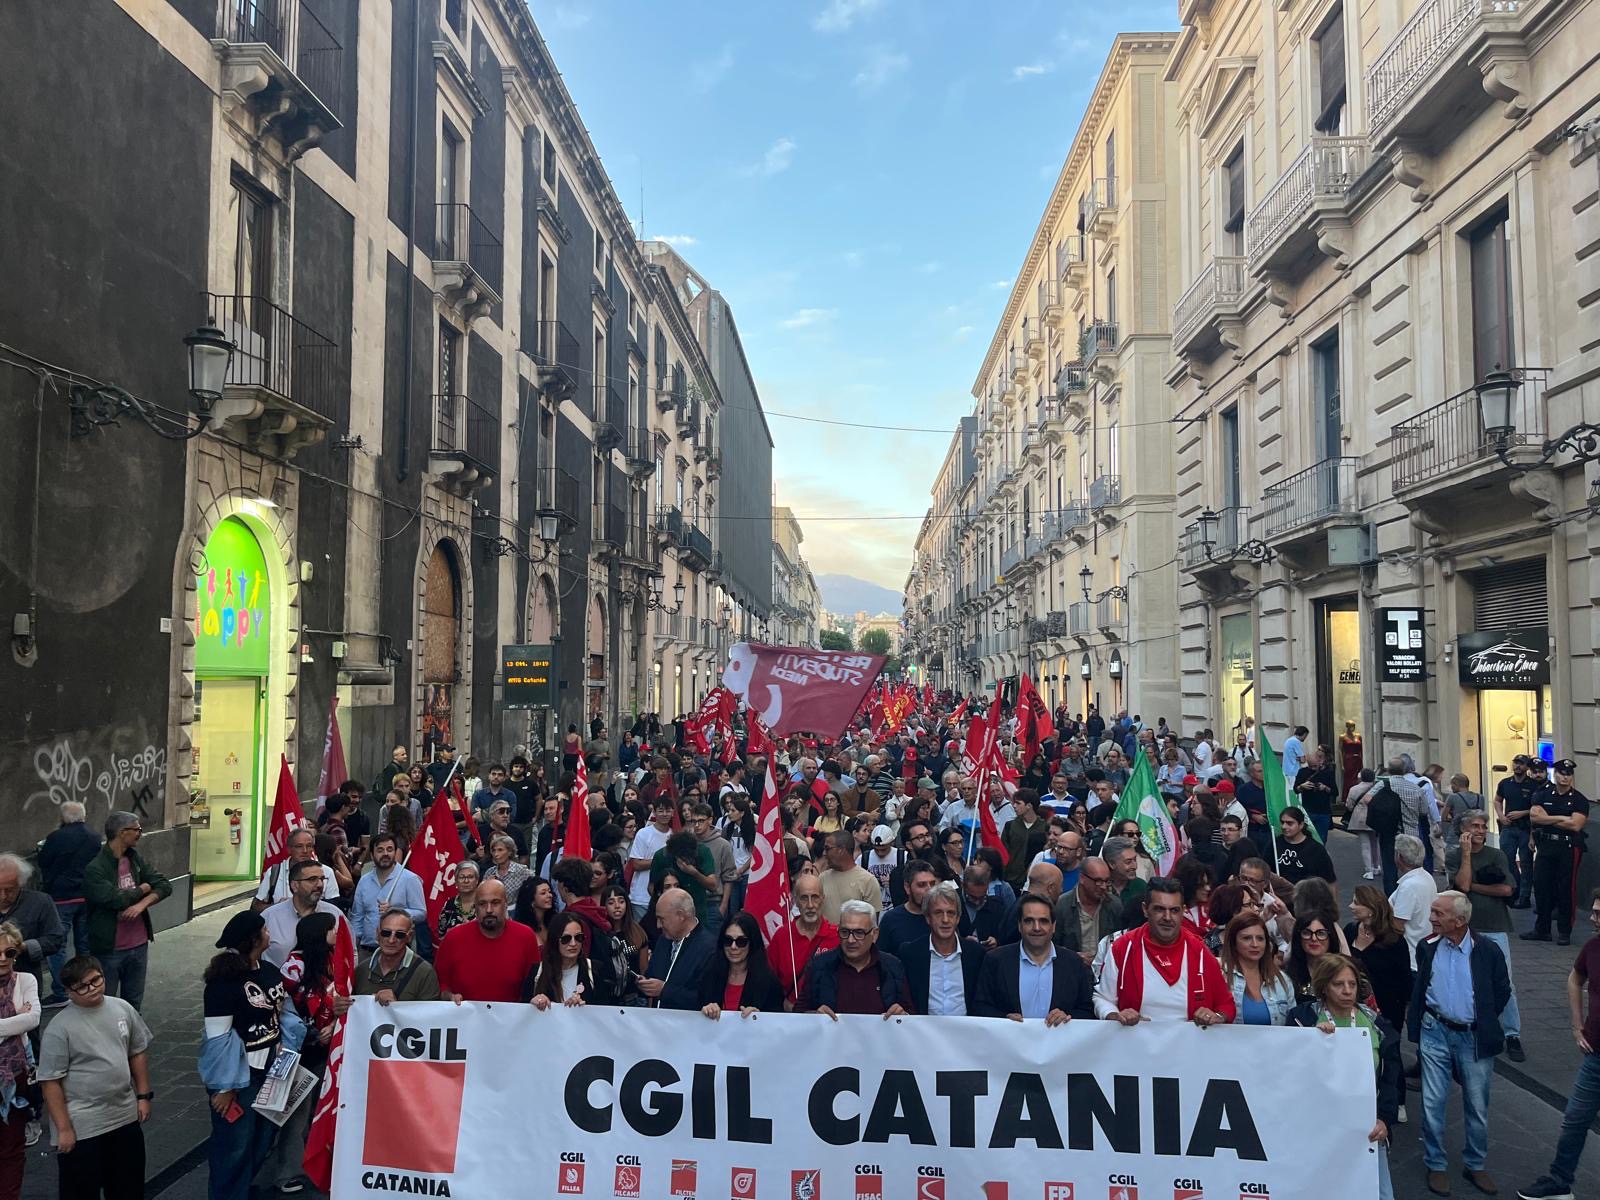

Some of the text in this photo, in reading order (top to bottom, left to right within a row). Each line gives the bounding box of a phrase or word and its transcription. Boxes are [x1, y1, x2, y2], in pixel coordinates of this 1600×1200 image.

[1388, 611, 1418, 649] T
[1340, 671, 1360, 681] CEME
[370, 1024, 467, 1060] CGIL
[257, 1077, 276, 1106] ORGAN
[564, 1056, 1267, 1161] CGIL CATANIA
[560, 1152, 585, 1163] CGIL
[616, 1155, 641, 1166] CGIL
[854, 1165, 883, 1175] CGIL
[917, 1166, 945, 1177] CGIL
[362, 1171, 451, 1198] CATANIA
[1109, 1174, 1137, 1186] CGIL
[1174, 1179, 1203, 1190] CGIL
[1239, 1182, 1269, 1194] CGIL
[614, 1189, 640, 1199] FILCAMS
